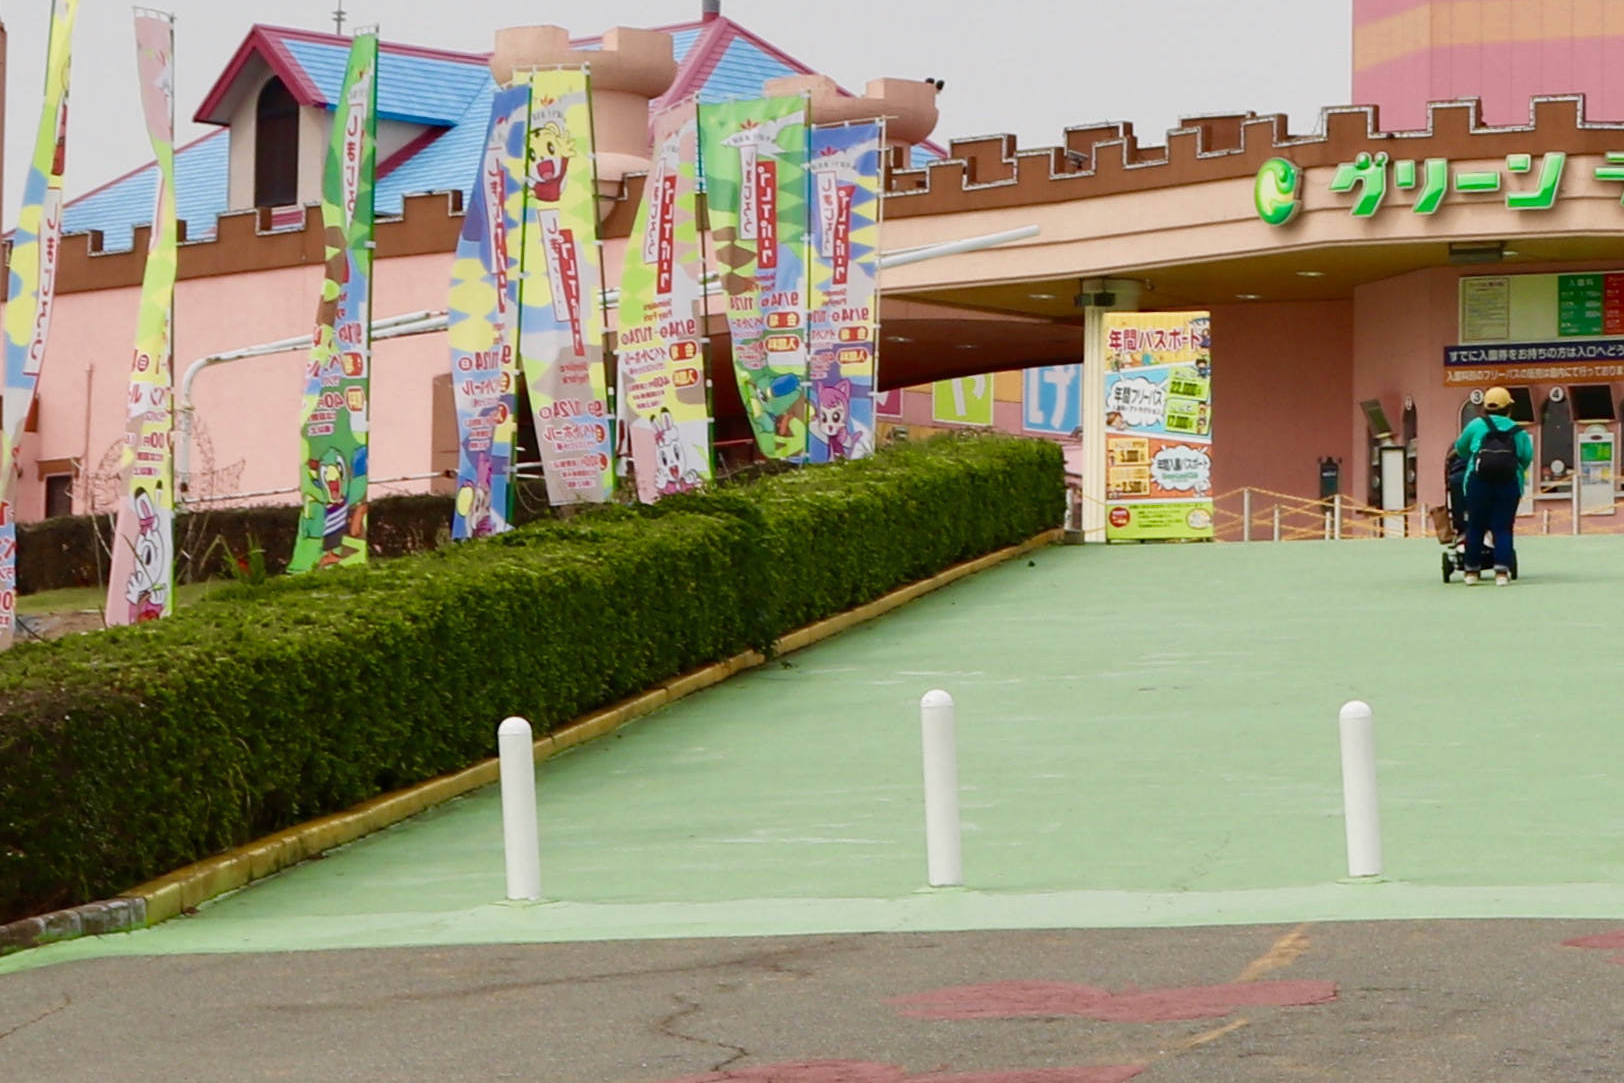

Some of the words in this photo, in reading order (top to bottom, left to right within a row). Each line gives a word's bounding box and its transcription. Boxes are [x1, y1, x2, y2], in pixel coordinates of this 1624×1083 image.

[1109, 328, 1201, 352] 年間パスポート
[1113, 386, 1163, 406] 年間フリーパス
